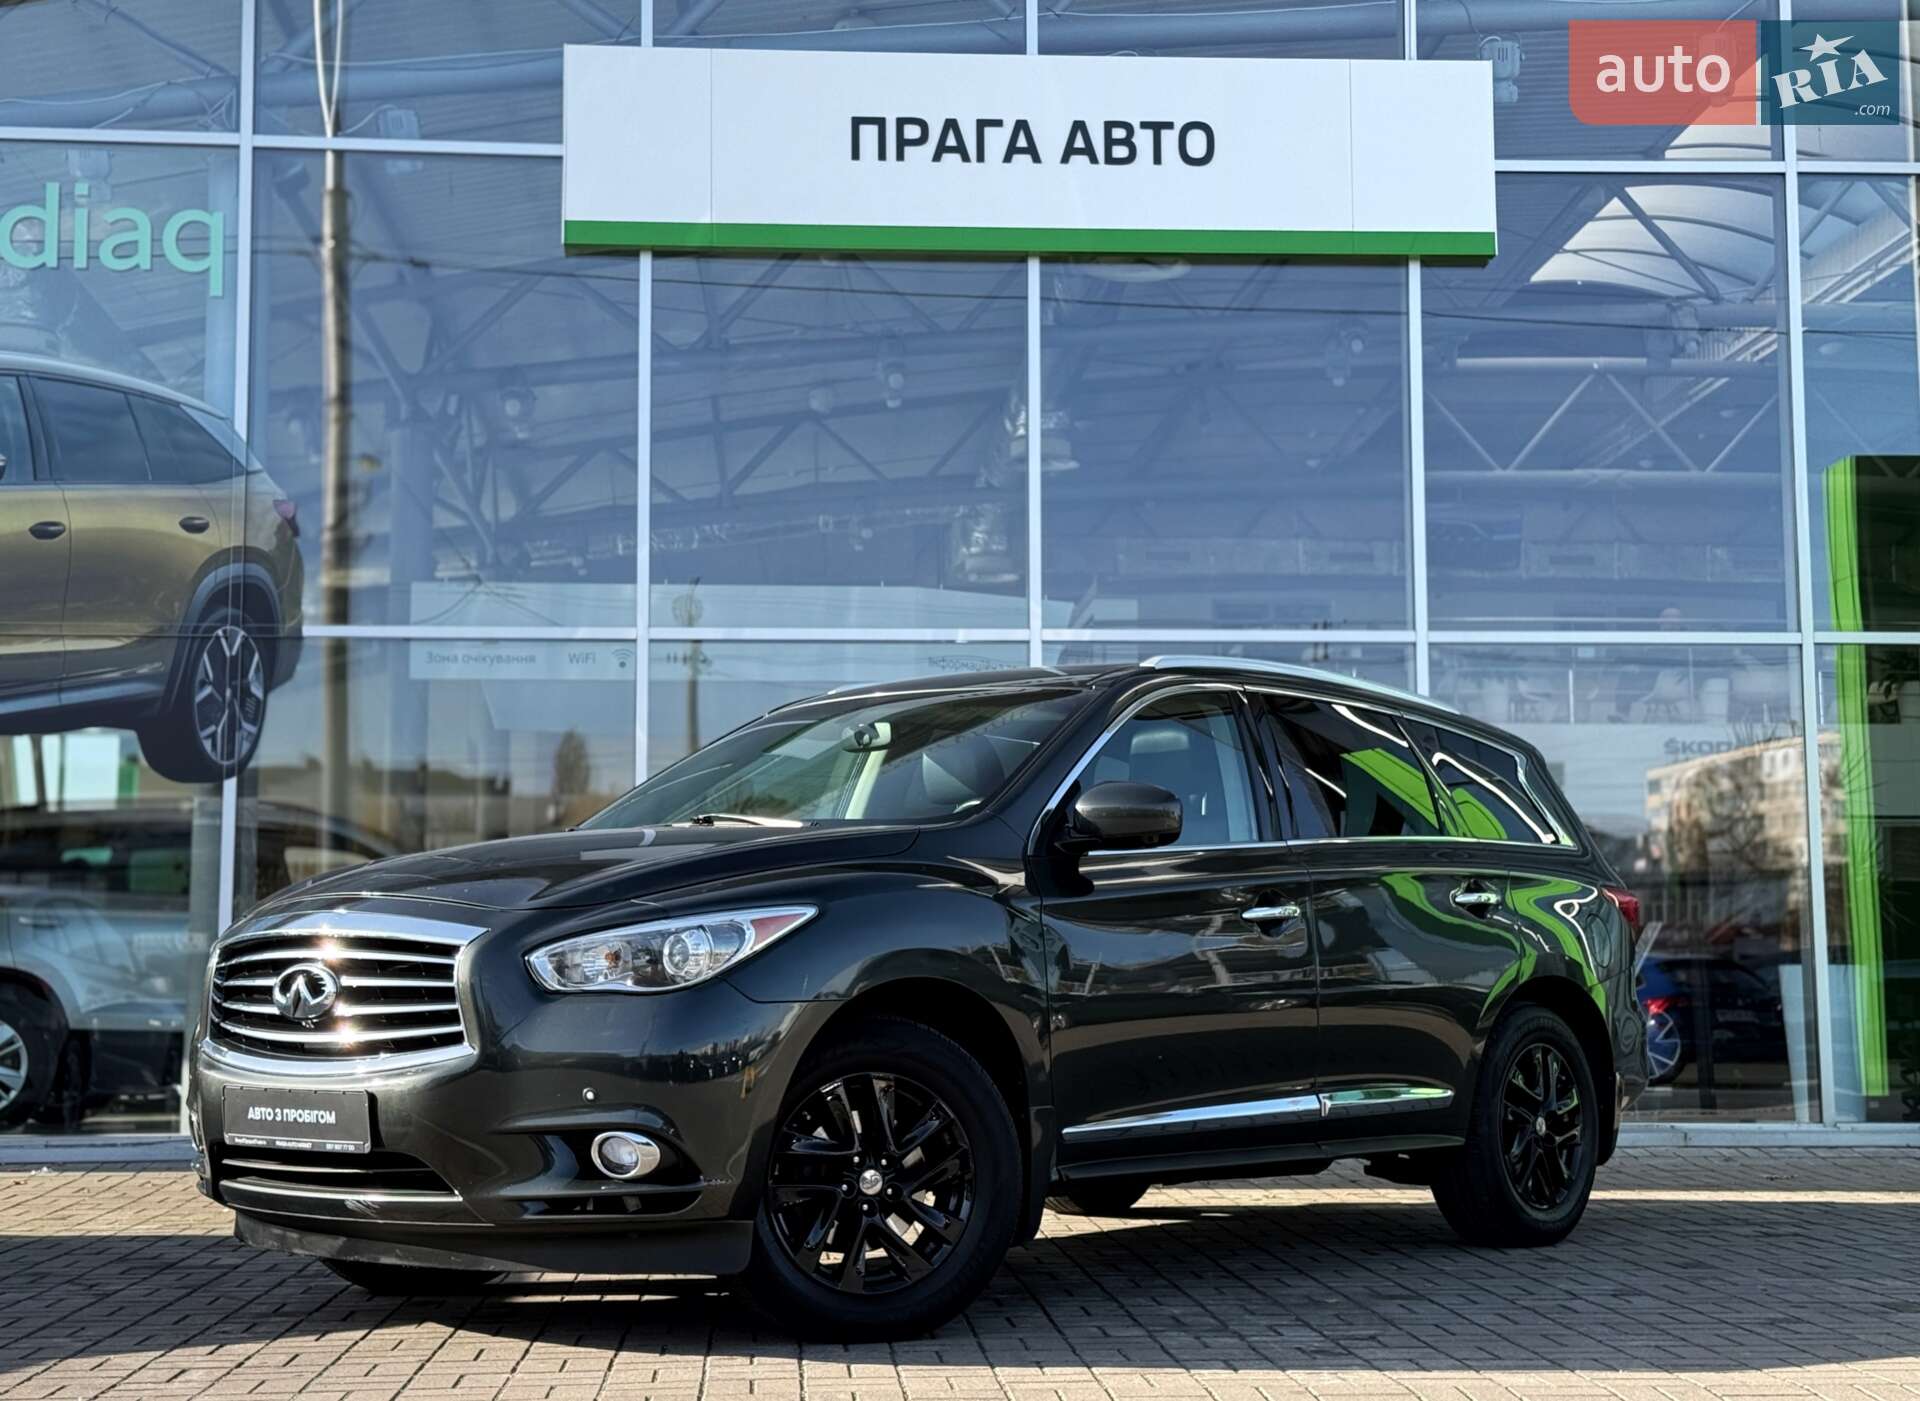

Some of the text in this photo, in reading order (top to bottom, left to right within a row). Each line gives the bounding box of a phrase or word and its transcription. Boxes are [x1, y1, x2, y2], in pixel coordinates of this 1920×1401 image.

[851, 115, 1216, 167] ПРАГА АВТО
[425, 652, 536, 668] Зона очікування
[568, 651, 596, 665] WiFi
[1663, 737, 1738, 755] ŠKOD
[247, 1106, 274, 1121] АВТО
[283, 1108, 336, 1124] ПРОБІГОМ
